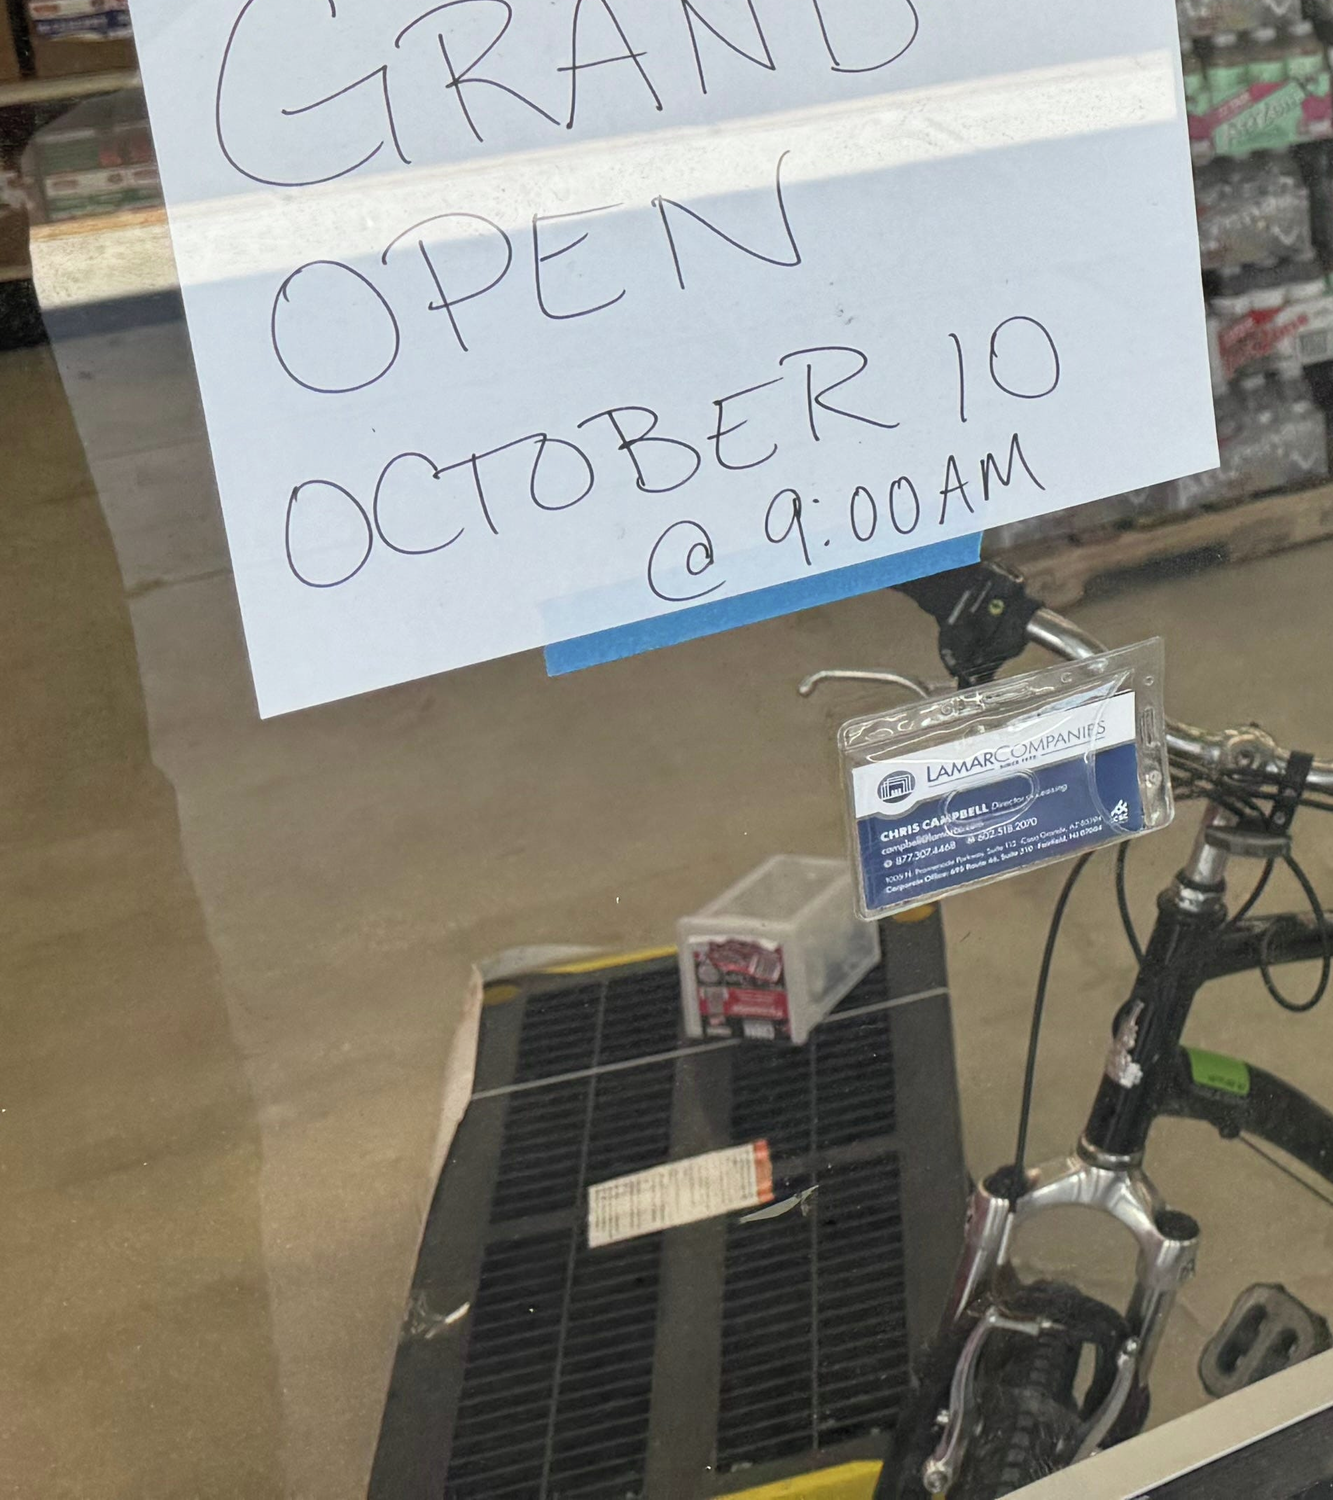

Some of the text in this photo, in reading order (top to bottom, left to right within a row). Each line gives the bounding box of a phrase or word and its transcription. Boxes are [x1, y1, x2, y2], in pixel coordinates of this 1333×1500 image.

[271, 149, 802, 394] OPEN
[284, 315, 1061, 587] OCTOBER 10
[647, 520, 725, 601] @
[880, 822, 920, 842] CHRIS
[922, 803, 989, 831] CAMPBELL
[991, 794, 1025, 811] Director
